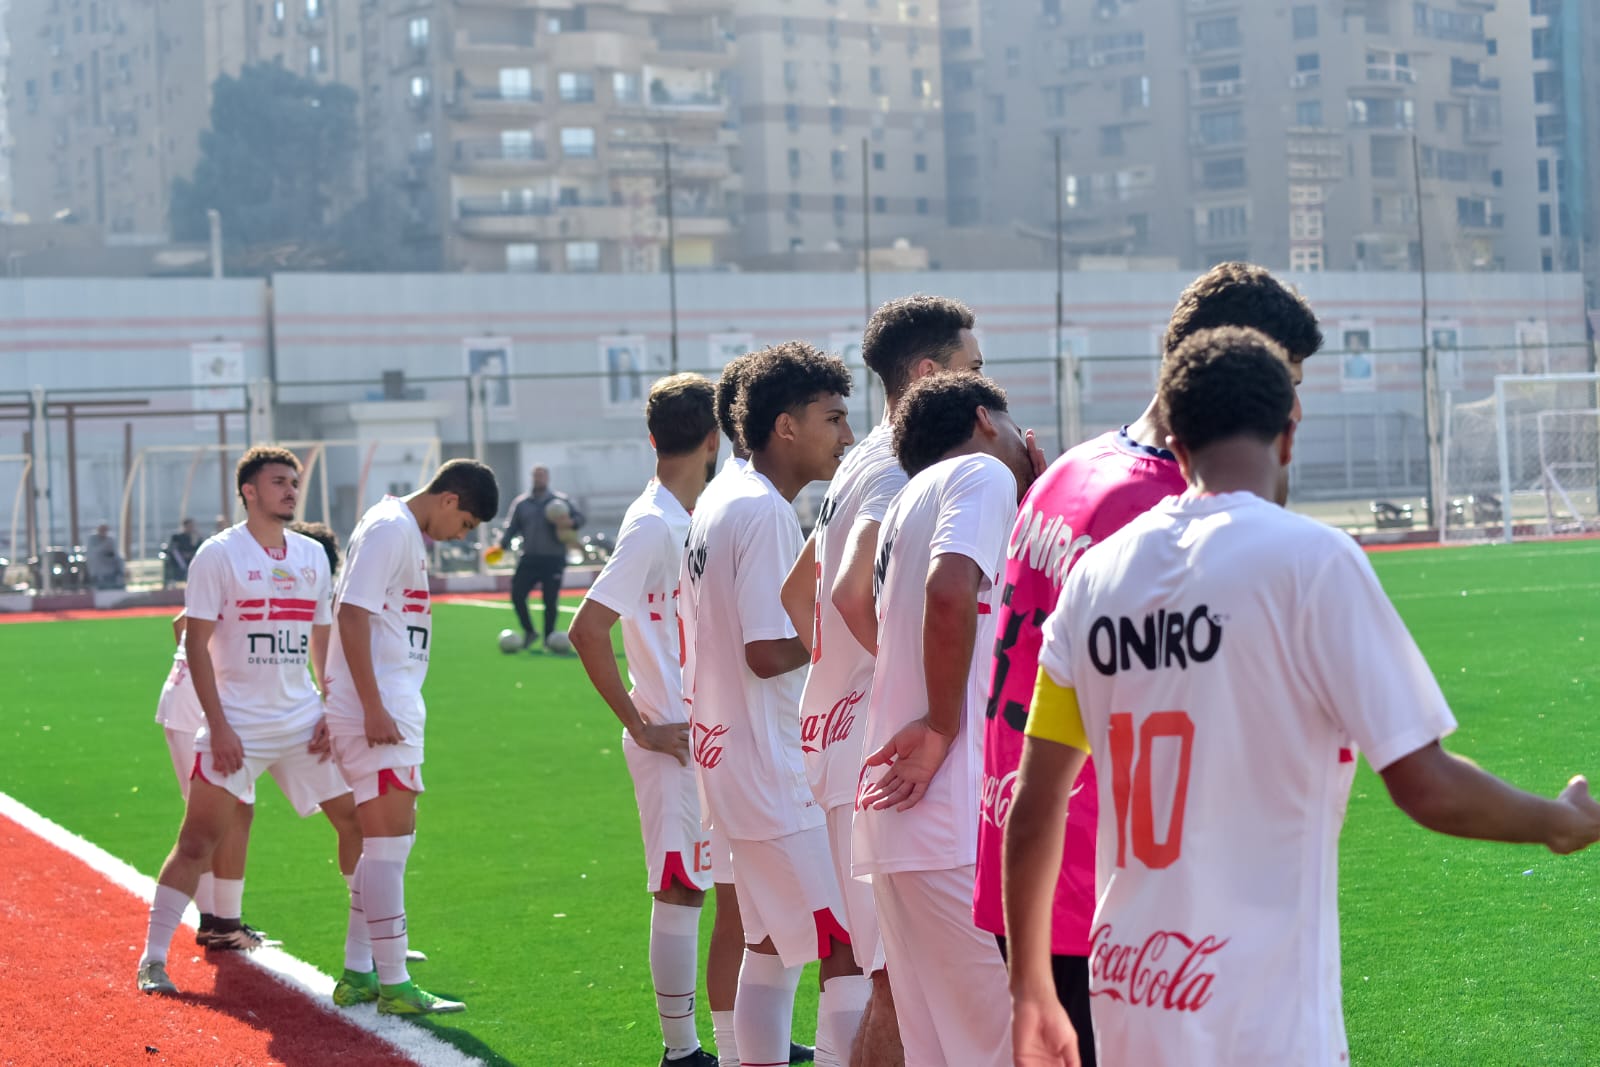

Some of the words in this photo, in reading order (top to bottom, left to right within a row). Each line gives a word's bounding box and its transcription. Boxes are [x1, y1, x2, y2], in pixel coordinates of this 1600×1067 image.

[1088, 604, 1222, 677] ONIRO
[1109, 711, 1195, 869] 10
[1090, 923, 1231, 1012] Coca-Cola
